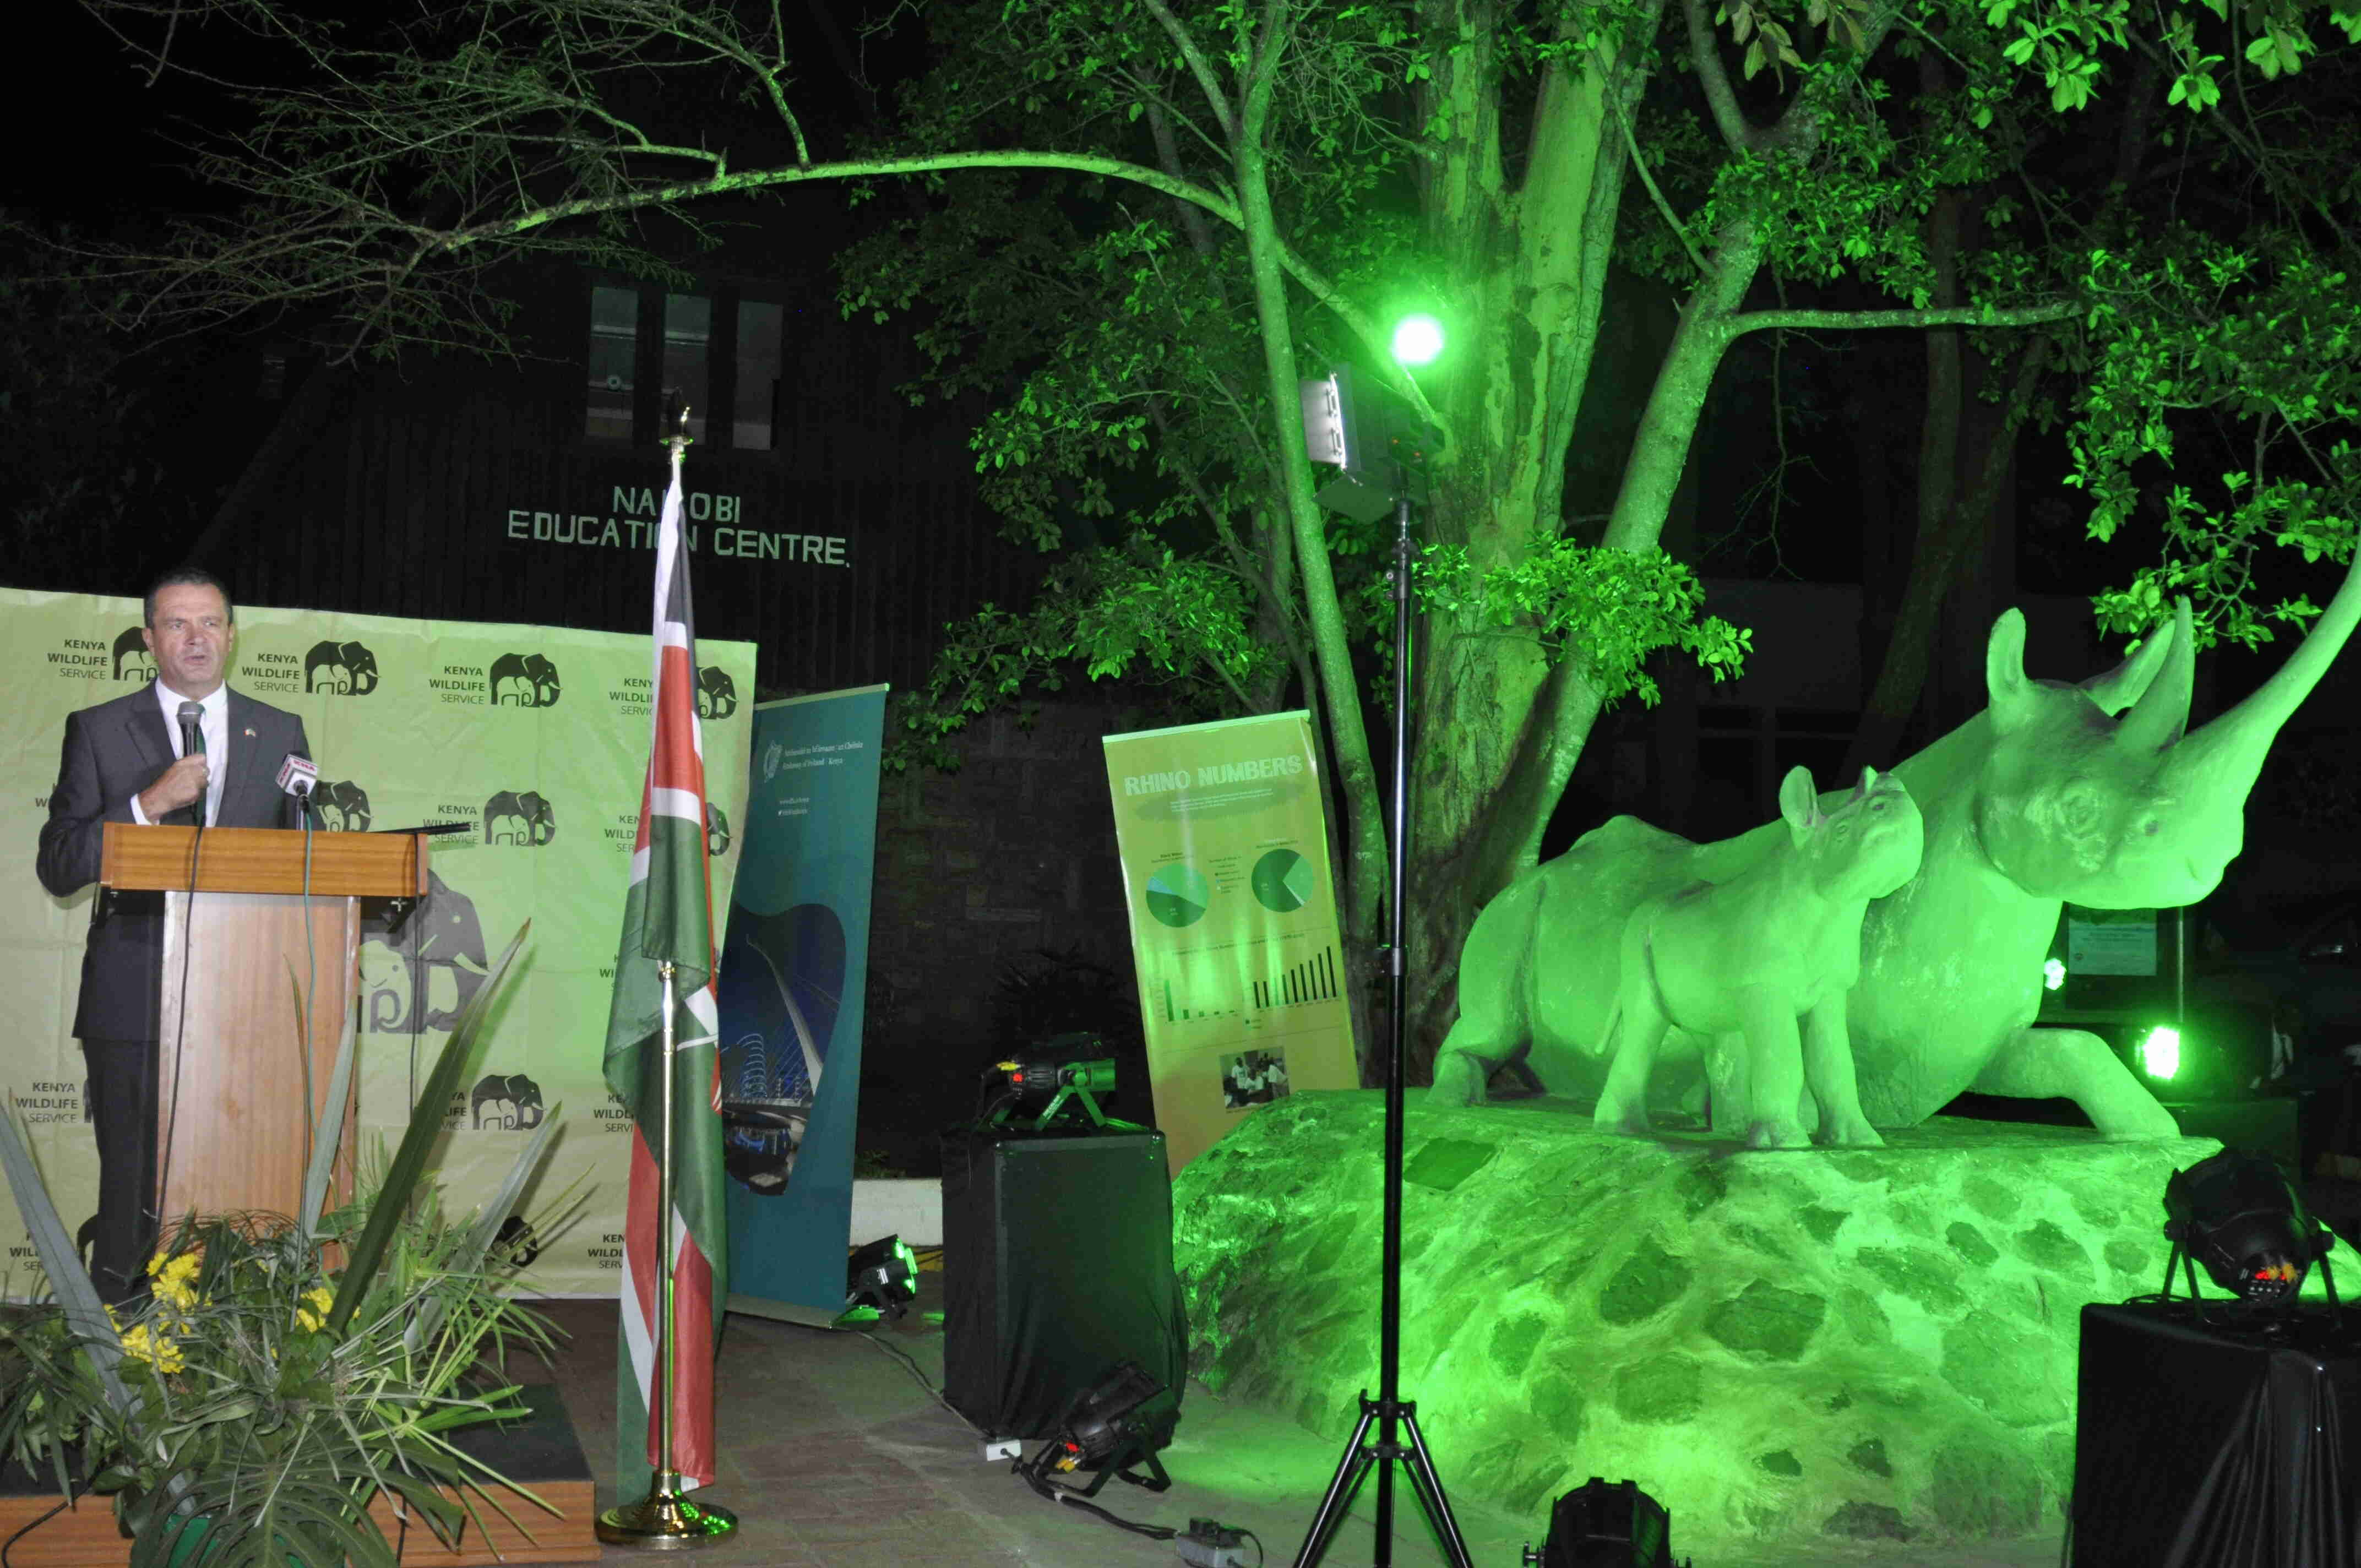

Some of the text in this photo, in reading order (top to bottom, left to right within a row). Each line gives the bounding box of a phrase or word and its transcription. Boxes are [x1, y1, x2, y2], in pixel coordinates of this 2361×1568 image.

[613, 486, 740, 524] NAOBI
[508, 509, 850, 568] EDUCATIN CENTRE.
[64, 639, 106, 650] KENYA
[47, 653, 107, 666] WILDLIFE
[258, 653, 298, 664] KENYA
[59, 668, 106, 679] SERVICE
[242, 666, 300, 679] WILDLIFE
[444, 665, 483, 676] KENYA
[254, 682, 300, 693] SERVICE
[429, 678, 485, 692] WILDLIFE
[624, 678, 652, 688] KENY
[440, 693, 485, 704] SERVICE
[609, 691, 652, 703] WILDLI
[621, 705, 652, 715] SERVI
[1124, 755, 1303, 796] RHINO NUMBERS
[438, 804, 477, 815] KENYA
[423, 819, 480, 831] WILE
[619, 815, 639, 824] KEN
[435, 834, 480, 845] SERVICE
[604, 829, 635, 839] WILD
[32, 1082, 75, 1092] KENYA
[15, 1098, 78, 1109] WILDLIFE
[29, 1113, 78, 1123] SERVICE
[594, 1109, 634, 1119] WILDL
[605, 1123, 633, 1132] SERVI
[603, 1234, 625, 1243] KEN
[587, 1249, 623, 1257] WILD
[599, 1260, 623, 1268] SERV
